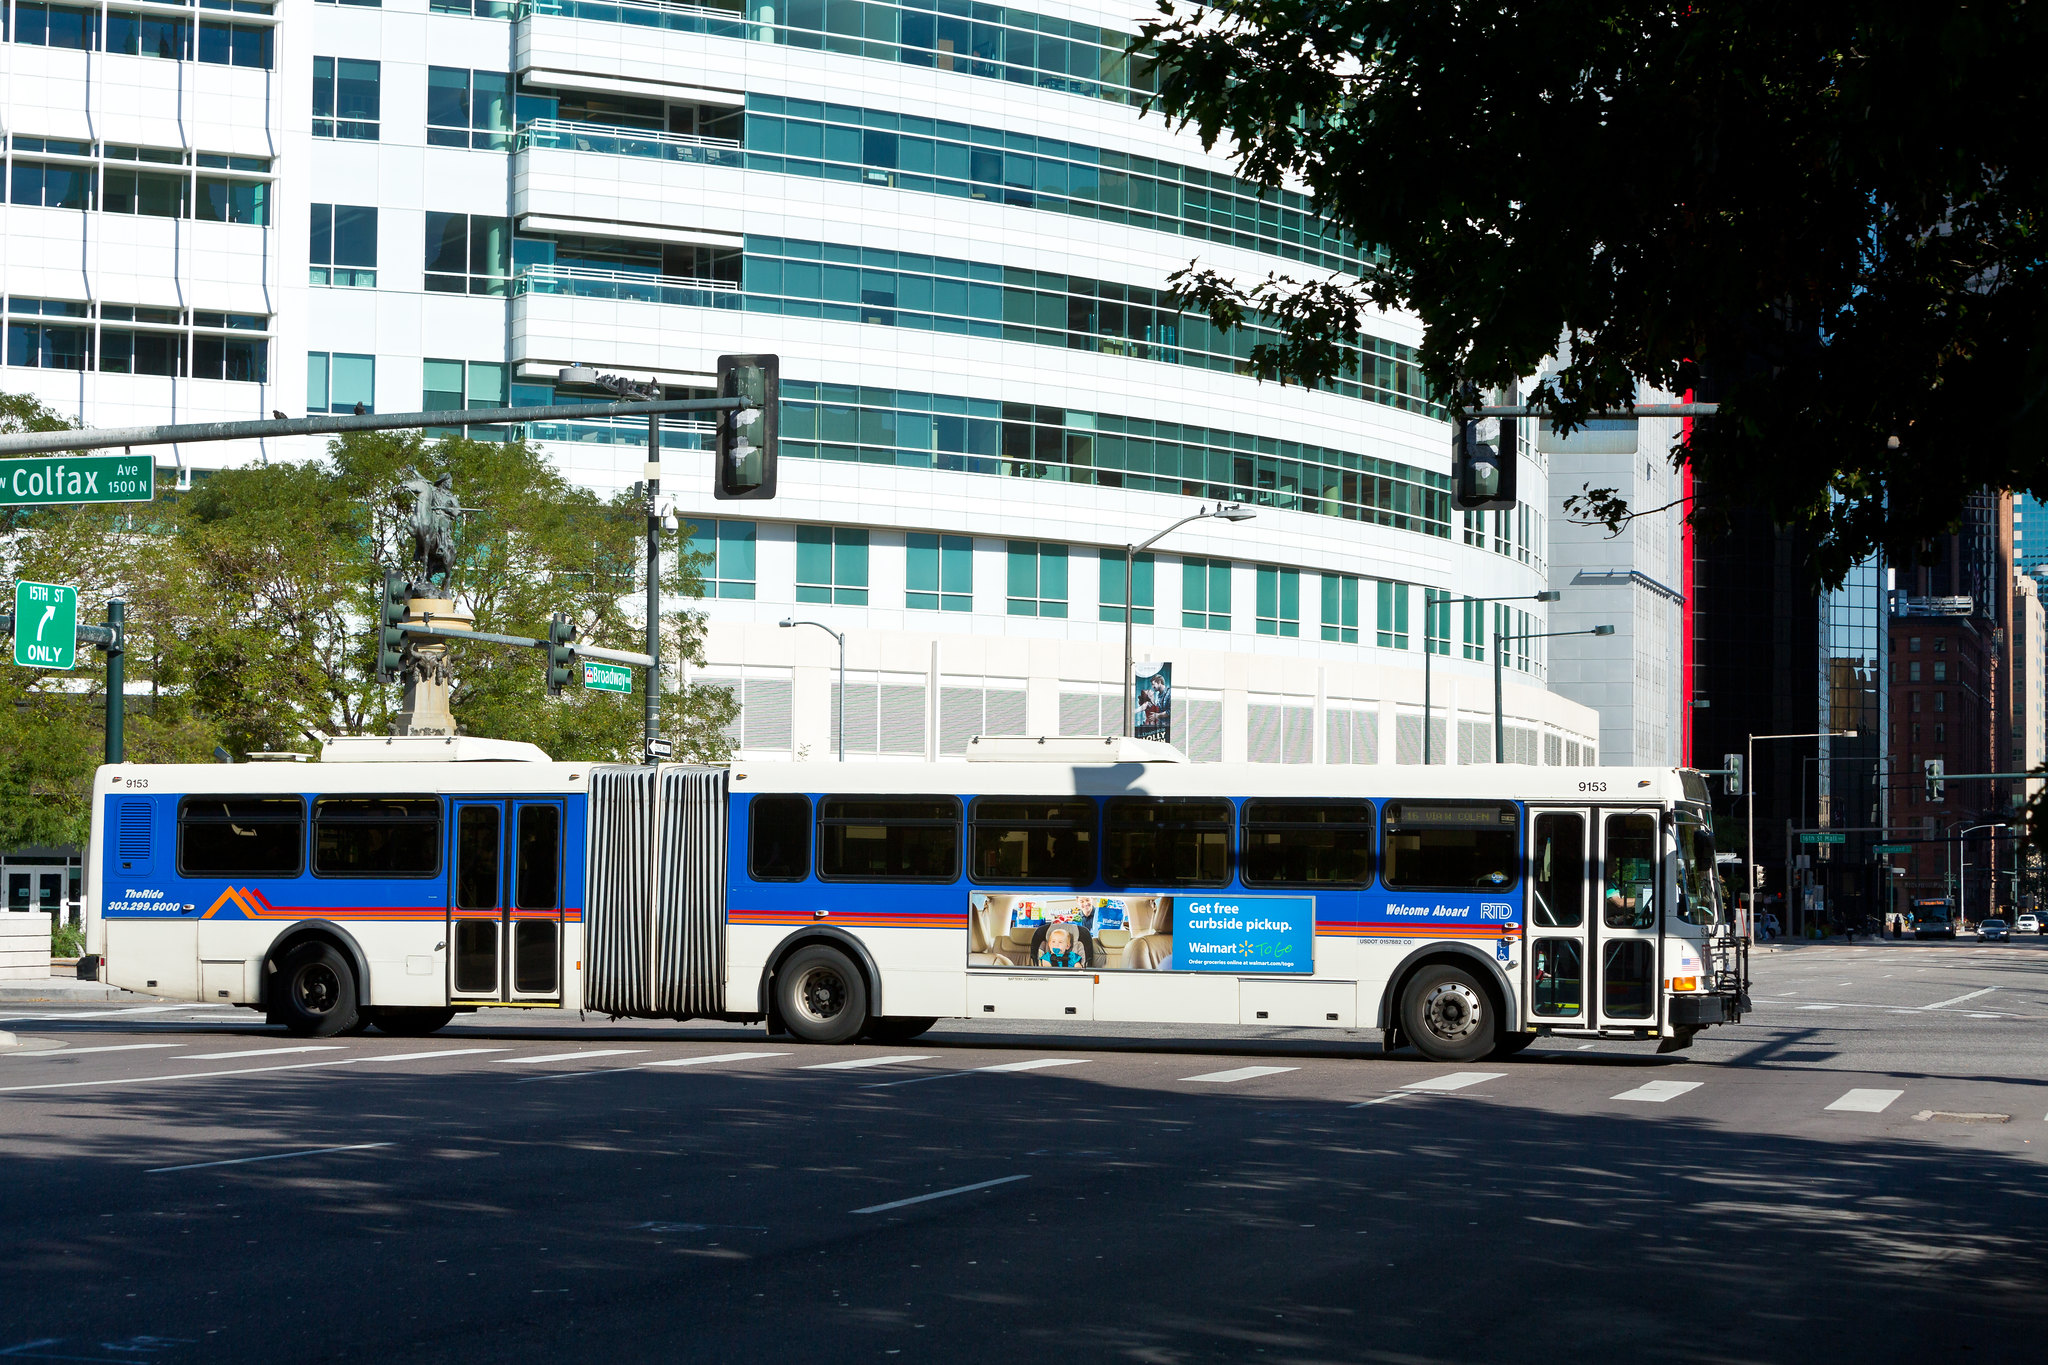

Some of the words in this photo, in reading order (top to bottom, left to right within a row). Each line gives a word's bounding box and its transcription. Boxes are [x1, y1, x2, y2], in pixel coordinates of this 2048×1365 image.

[117, 464, 138, 476] Ave
[13, 465, 99, 497] Colfax
[108, 481, 136, 493] 1500
[139, 480, 147, 492] N
[29, 586, 49, 602] 15TH
[54, 589, 65, 603] ST
[27, 644, 62, 663] ONLY
[593, 666, 626, 690] Broadway
[126, 779, 149, 788] 9153
[1578, 781, 1607, 792] 9153
[124, 889, 164, 899] TheRide
[107, 901, 180, 912] 303.299.6000
[1189, 902, 1211, 914] Get
[1213, 902, 1239, 914] free
[1386, 903, 1429, 917] Welcome
[1432, 904, 1470, 917] Aboard
[1480, 902, 1513, 920] RTD
[1188, 917, 1243, 929] curbside
[1246, 918, 1292, 933] pickup.
[1188, 942, 1237, 954] Walmart
